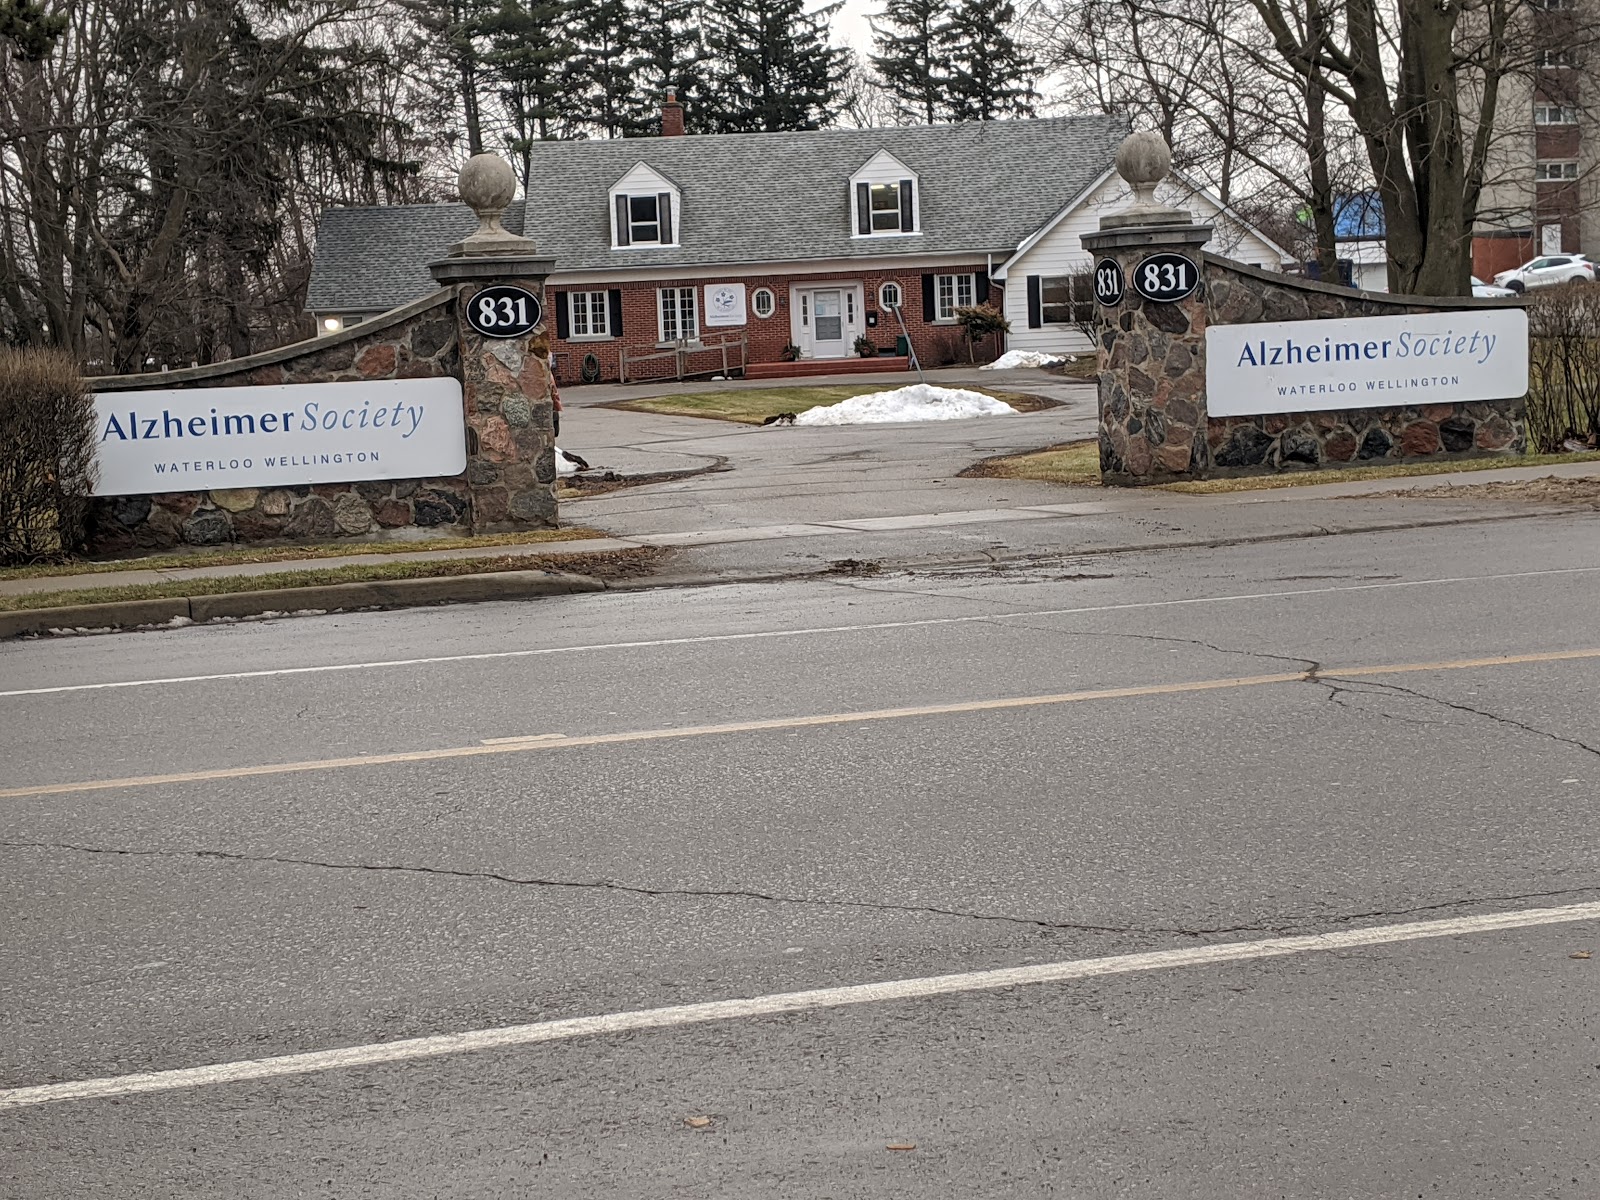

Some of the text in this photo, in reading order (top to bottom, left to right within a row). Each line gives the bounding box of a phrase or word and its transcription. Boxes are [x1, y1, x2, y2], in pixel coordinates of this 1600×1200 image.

[1097, 268, 1120, 297] 831
[1143, 263, 1189, 292] 831
[478, 296, 530, 327] 831
[1237, 330, 1496, 367] Alzheimer Society
[1277, 376, 1460, 396] WATERLOO WELLINGTON
[101, 400, 424, 441] Alzheimer Society
[154, 451, 380, 473] WATERLOO WELLINGTON
